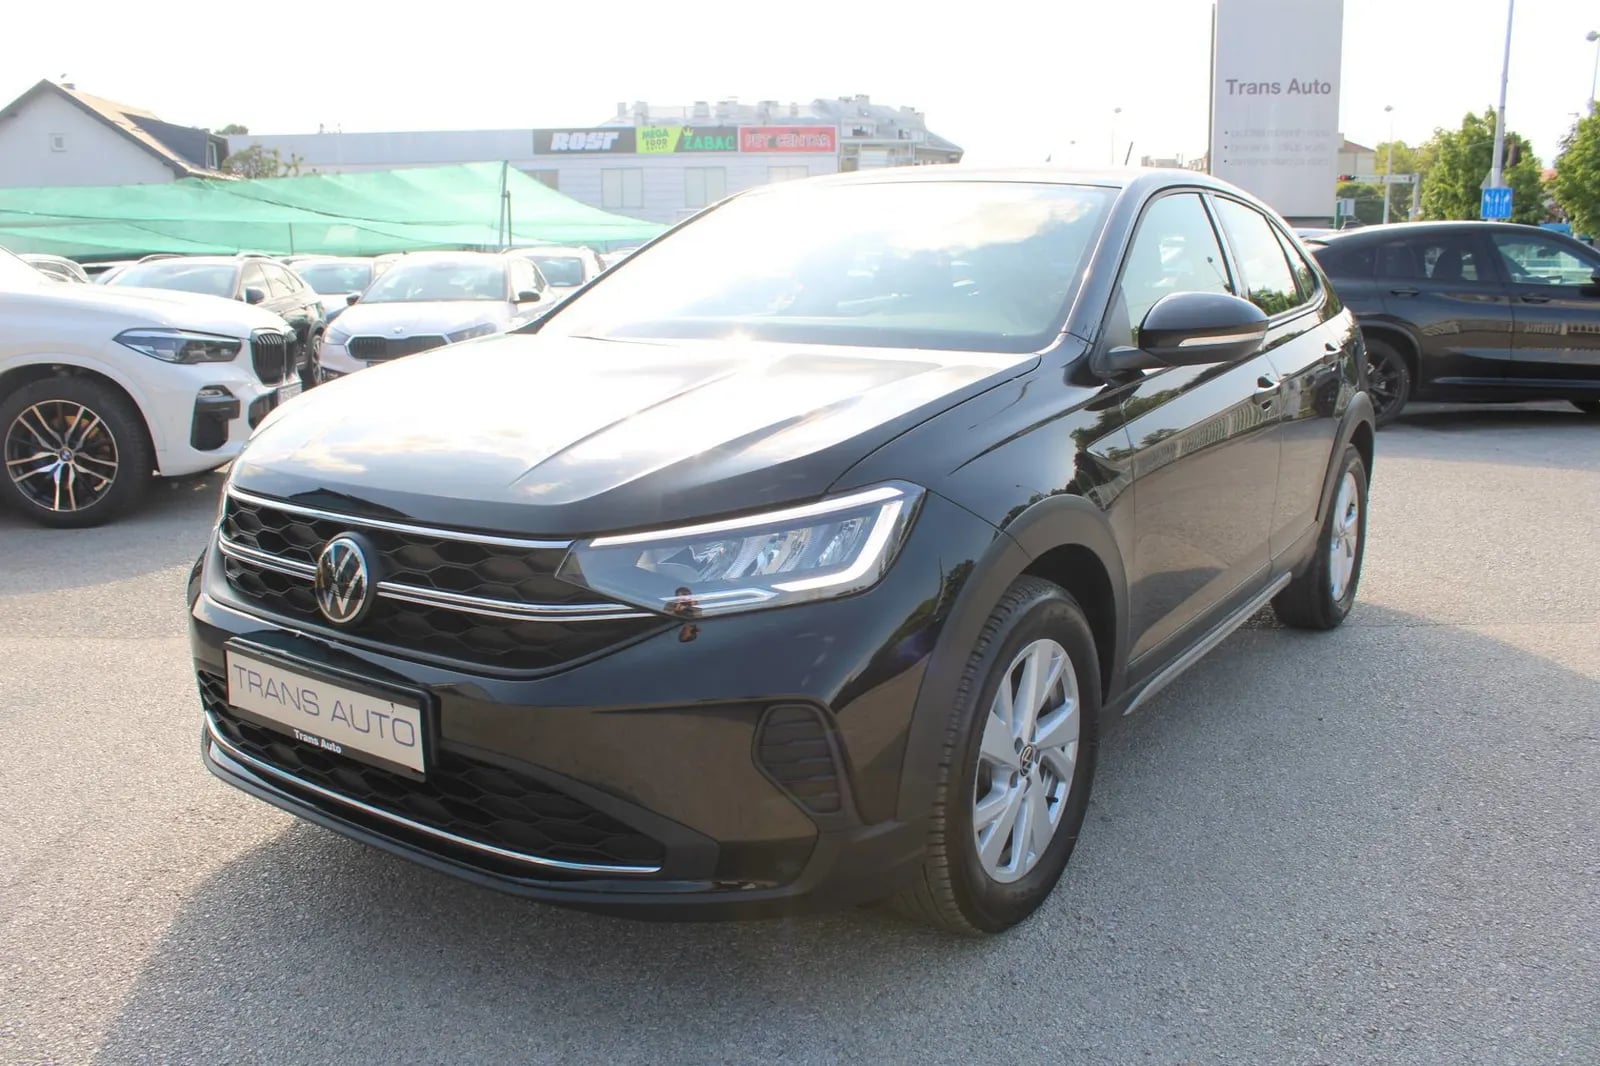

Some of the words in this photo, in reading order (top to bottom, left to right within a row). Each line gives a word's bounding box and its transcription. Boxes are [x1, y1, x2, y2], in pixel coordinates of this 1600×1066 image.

[1225, 79, 1281, 95] Trans
[1287, 78, 1332, 95] Auto
[550, 131, 619, 151] ROST
[233, 663, 320, 717] TRANS
[331, 700, 415, 747] AUTO
[293, 729, 319, 747] Trans
[320, 738, 342, 754] Auto
